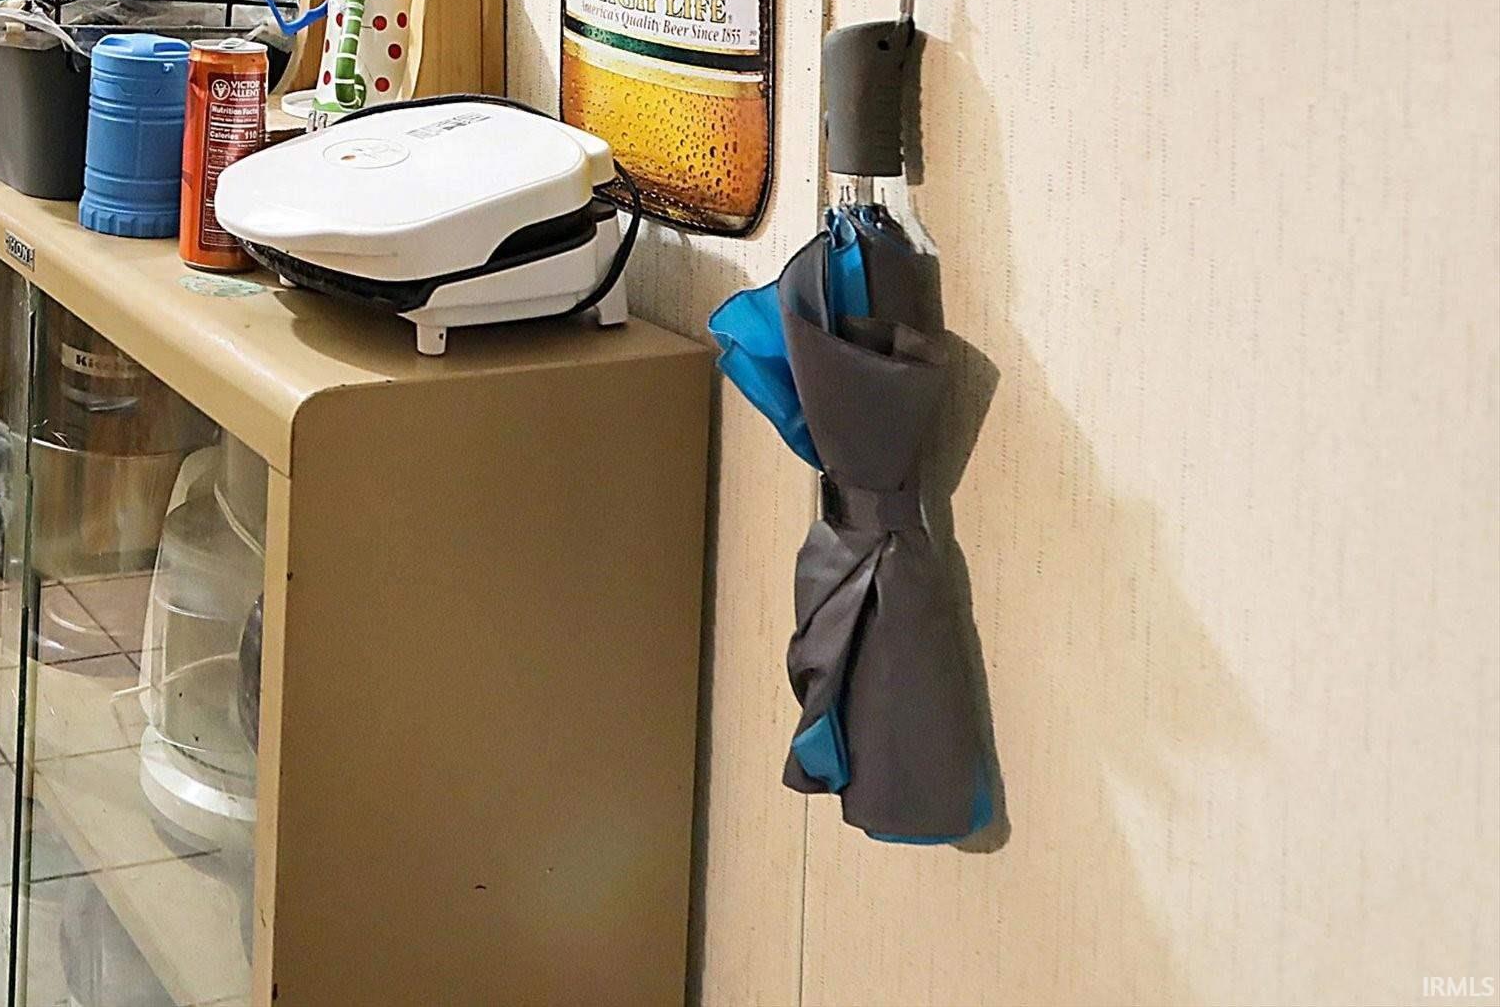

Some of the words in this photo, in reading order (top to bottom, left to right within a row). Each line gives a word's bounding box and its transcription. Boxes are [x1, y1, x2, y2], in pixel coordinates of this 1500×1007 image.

[581, 0, 620, 23] America's
[621, 10, 661, 34] Quality
[663, 19, 690, 37] Beer
[691, 24, 720, 43] Since
[720, 26, 742, 46] 1855
[230, 80, 260, 89] VICTOR
[211, 106, 242, 115] Nutrition
[209, 130, 239, 140] Calories
[244, 130, 258, 140] 110
